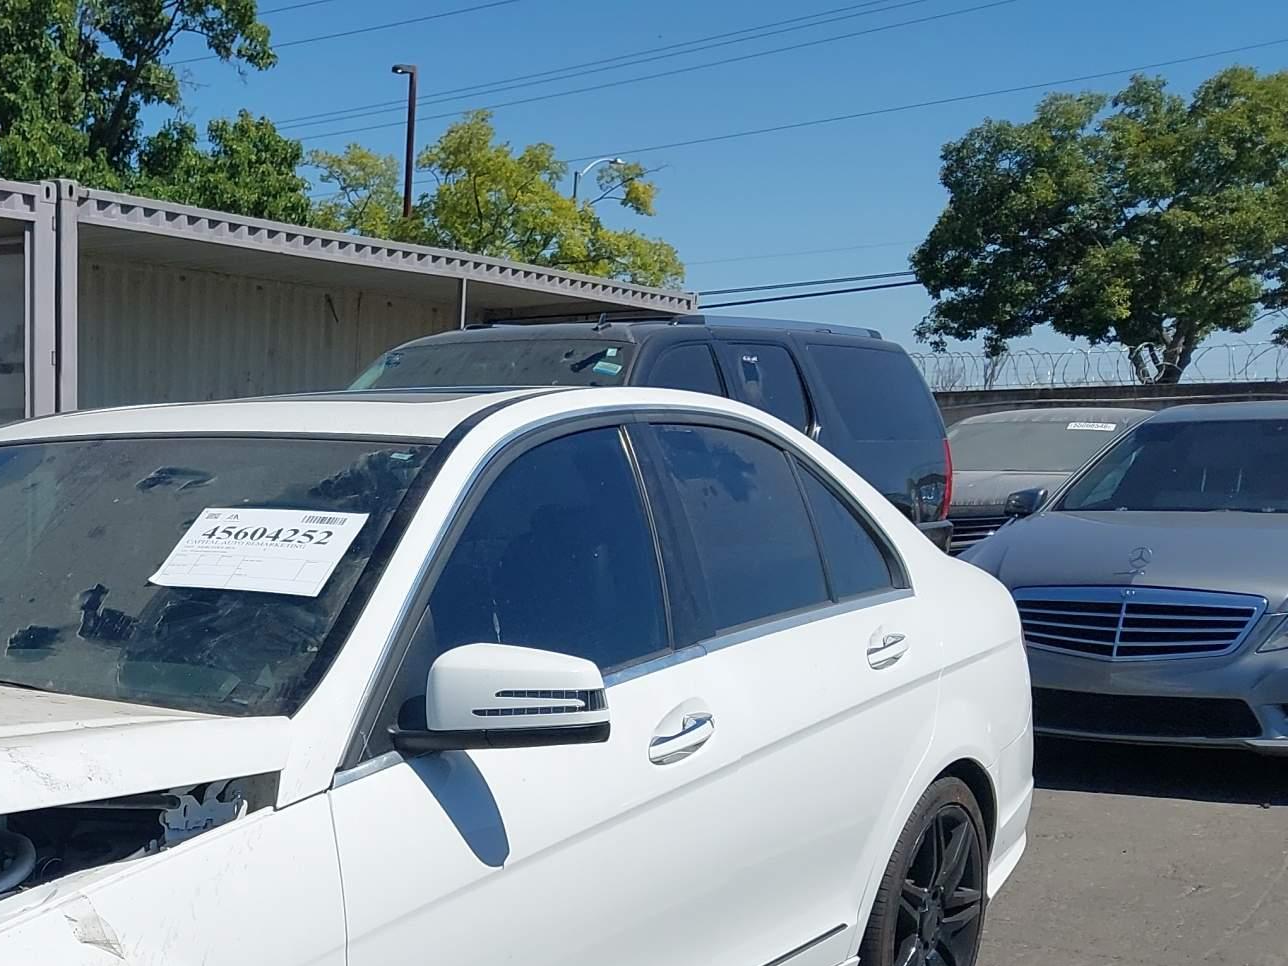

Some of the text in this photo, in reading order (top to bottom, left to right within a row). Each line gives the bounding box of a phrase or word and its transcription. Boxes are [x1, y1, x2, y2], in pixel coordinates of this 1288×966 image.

[202, 525, 334, 546] 45604252
[186, 538, 221, 546] CAPITAL
[244, 541, 307, 550] REMARKETING
